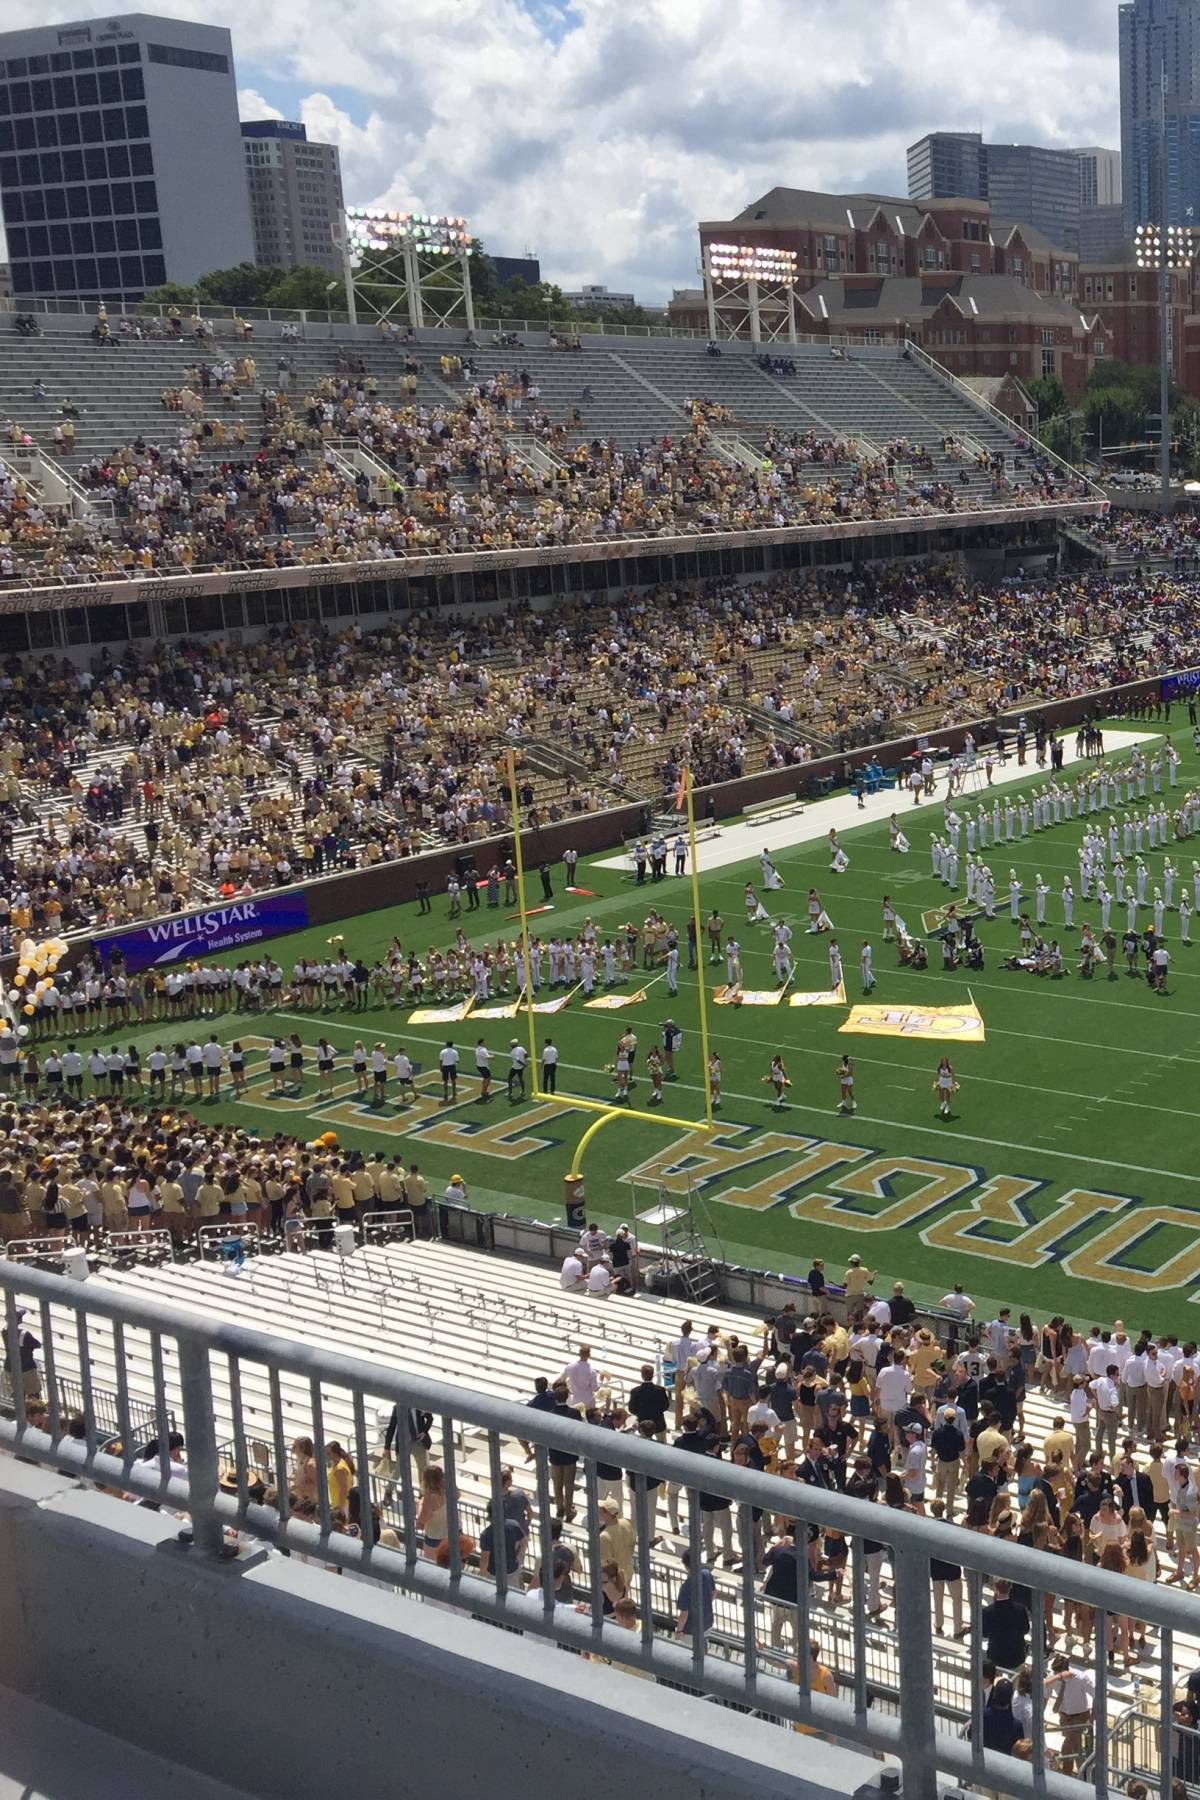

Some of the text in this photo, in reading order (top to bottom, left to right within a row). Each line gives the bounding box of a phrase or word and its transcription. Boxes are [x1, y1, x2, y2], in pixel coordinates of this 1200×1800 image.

[309, 574, 344, 586] DAVIS
[355, 568, 410, 581] HAMILTON
[228, 578, 279, 592] MORRIS
[8, 586, 99, 600] COLLEGE FOOTBALL
[137, 585, 205, 600] BAUGHAN
[38, 597, 63, 609] OF
[64, 592, 114, 608] FAME
[147, 902, 256, 942] WELLSTAR
[208, 928, 263, 949] Health System
